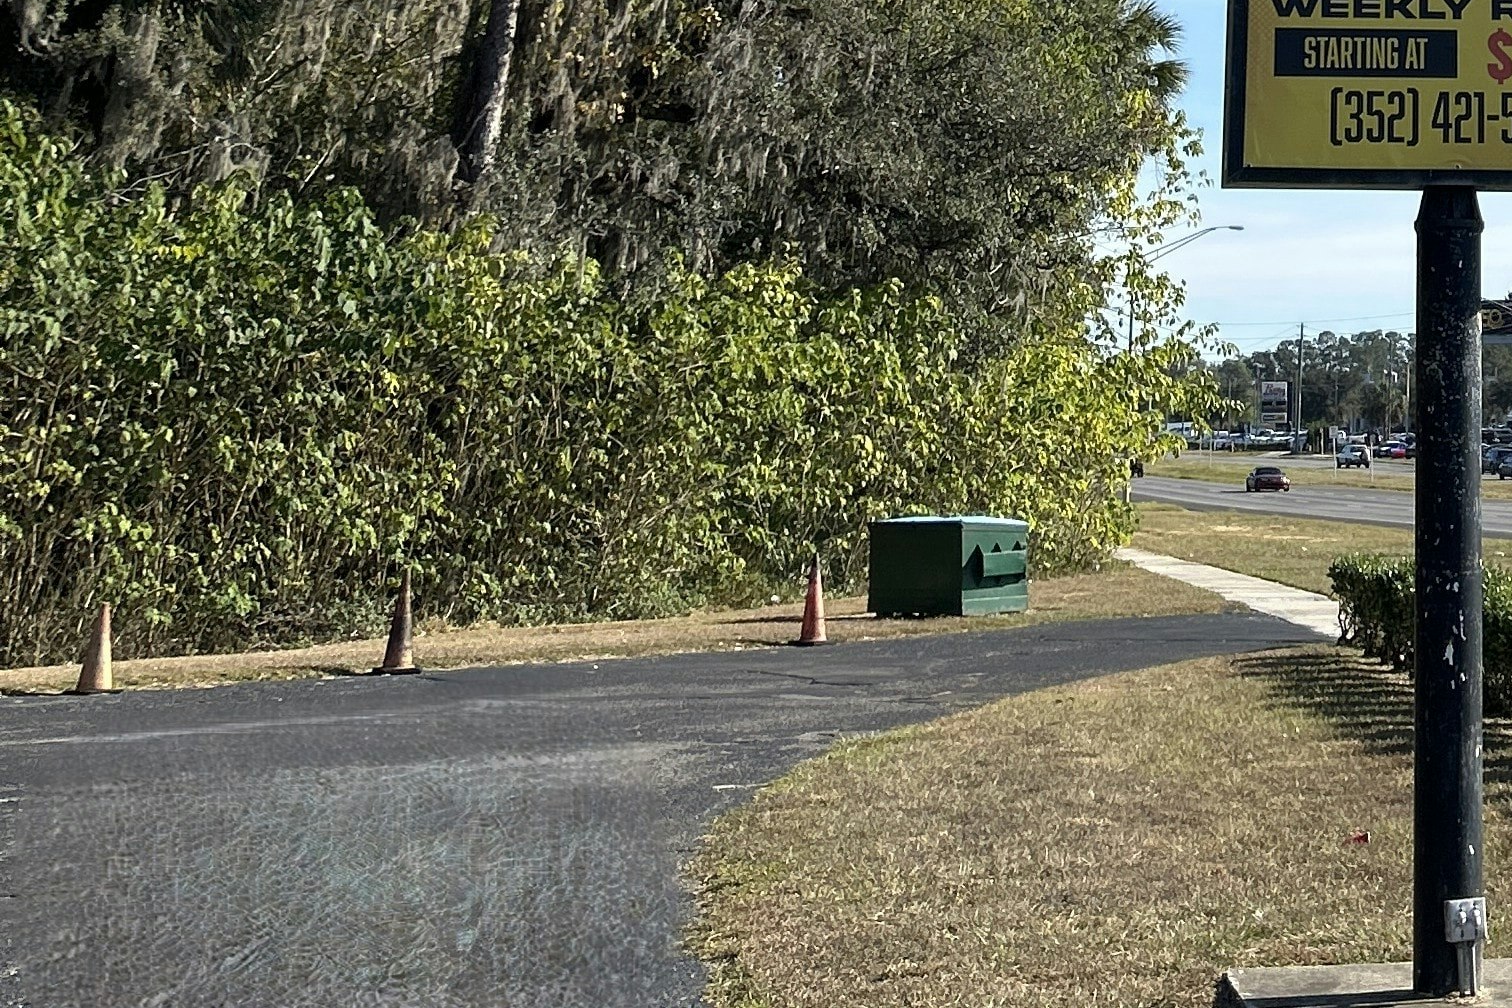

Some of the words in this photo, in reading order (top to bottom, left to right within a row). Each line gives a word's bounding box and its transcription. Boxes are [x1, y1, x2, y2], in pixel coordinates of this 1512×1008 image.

[1303, 36, 1399, 69] STARTING
[1405, 38, 1428, 70] AT
[1330, 86, 1420, 147] (352)
